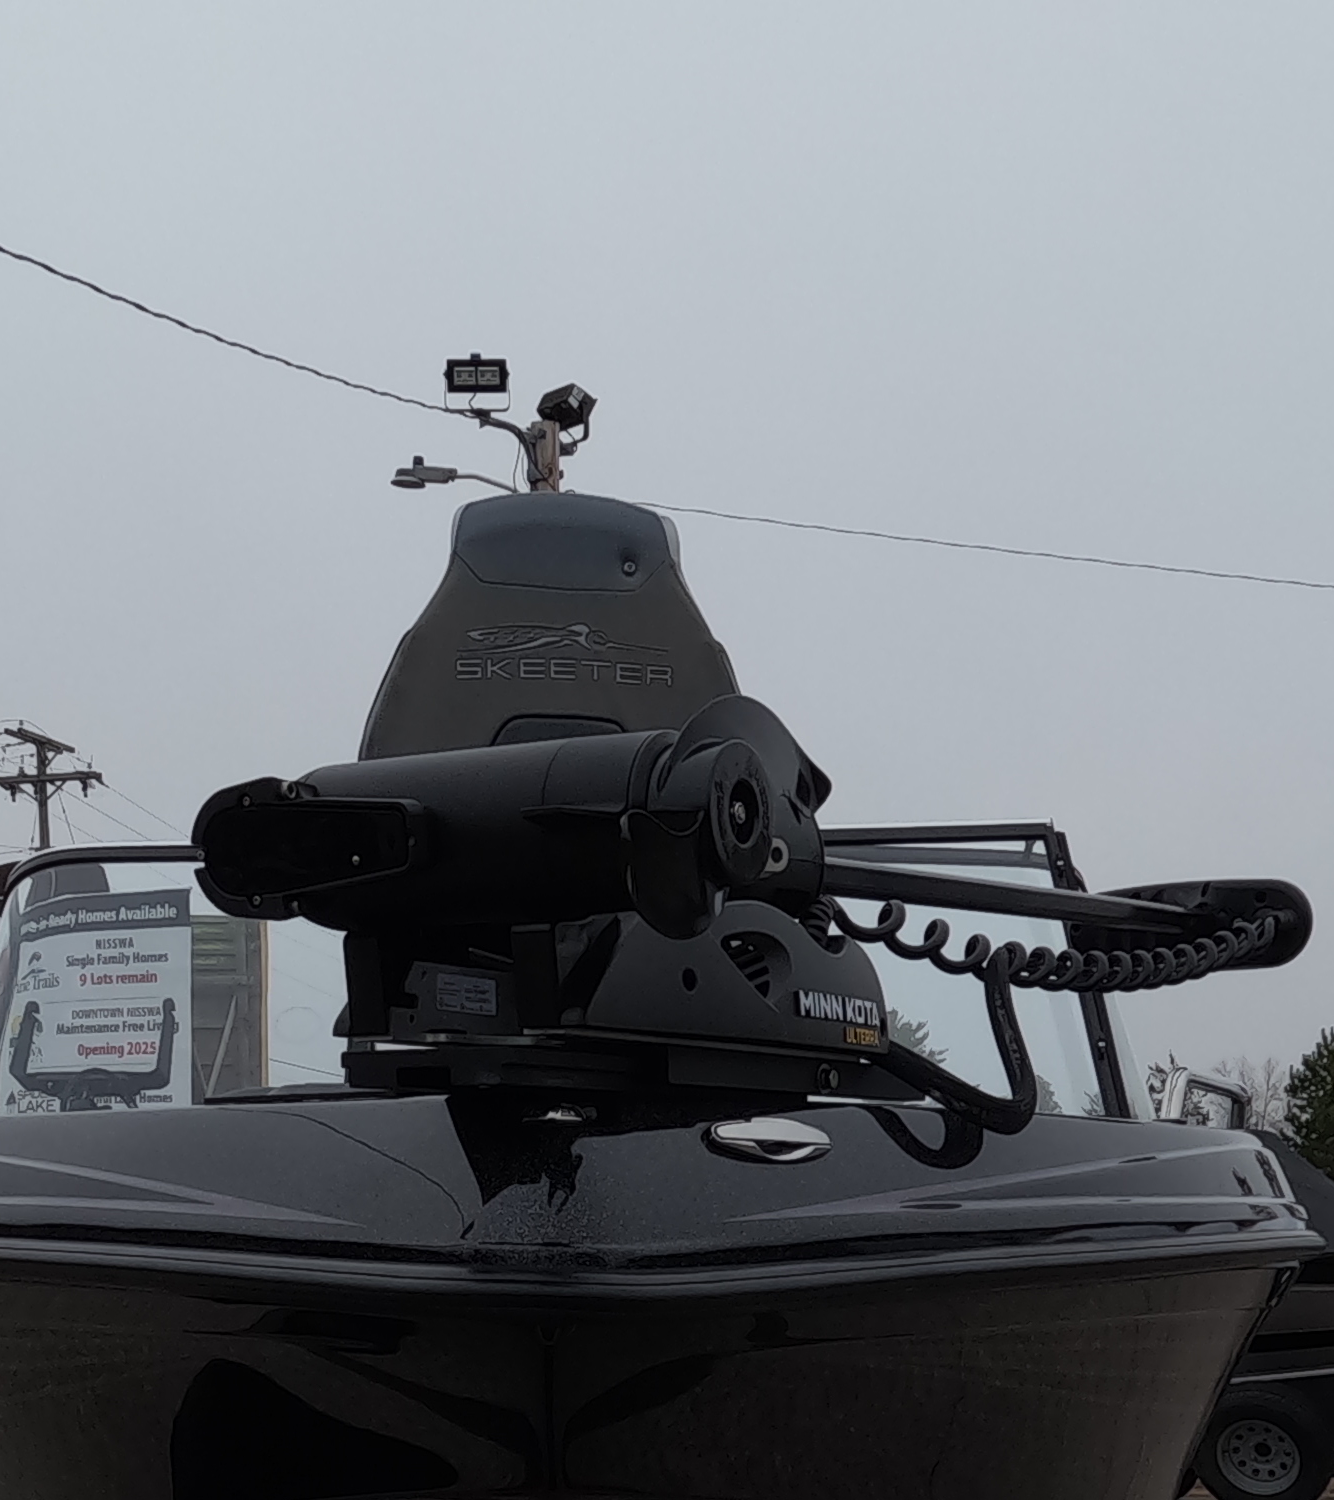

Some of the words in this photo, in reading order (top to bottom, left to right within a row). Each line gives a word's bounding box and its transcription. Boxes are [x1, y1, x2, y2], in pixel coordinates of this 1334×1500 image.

[455, 657, 674, 688] SKEETER
[78, 909, 117, 924] Homes
[118, 902, 177, 921] Available
[95, 937, 134, 950] NISSWA
[66, 953, 95, 969] Single
[97, 951, 130, 967] Family
[132, 951, 169, 963] Homes
[31, 973, 60, 990] Trails
[79, 973, 87, 987] 9
[90, 972, 113, 985] Lots
[115, 969, 158, 984] remain
[71, 1007, 124, 1020] DOWNTOWN
[126, 1006, 161, 1017] NISSWA
[797, 989, 844, 1021] MINN
[845, 996, 880, 1027] KOTA
[56, 1022, 120, 1035] Maintenance
[122, 1020, 145, 1032] Free
[77, 1043, 124, 1059] Opening
[126, 1041, 157, 1056] 2025
[17, 1099, 56, 1113] LAKE
